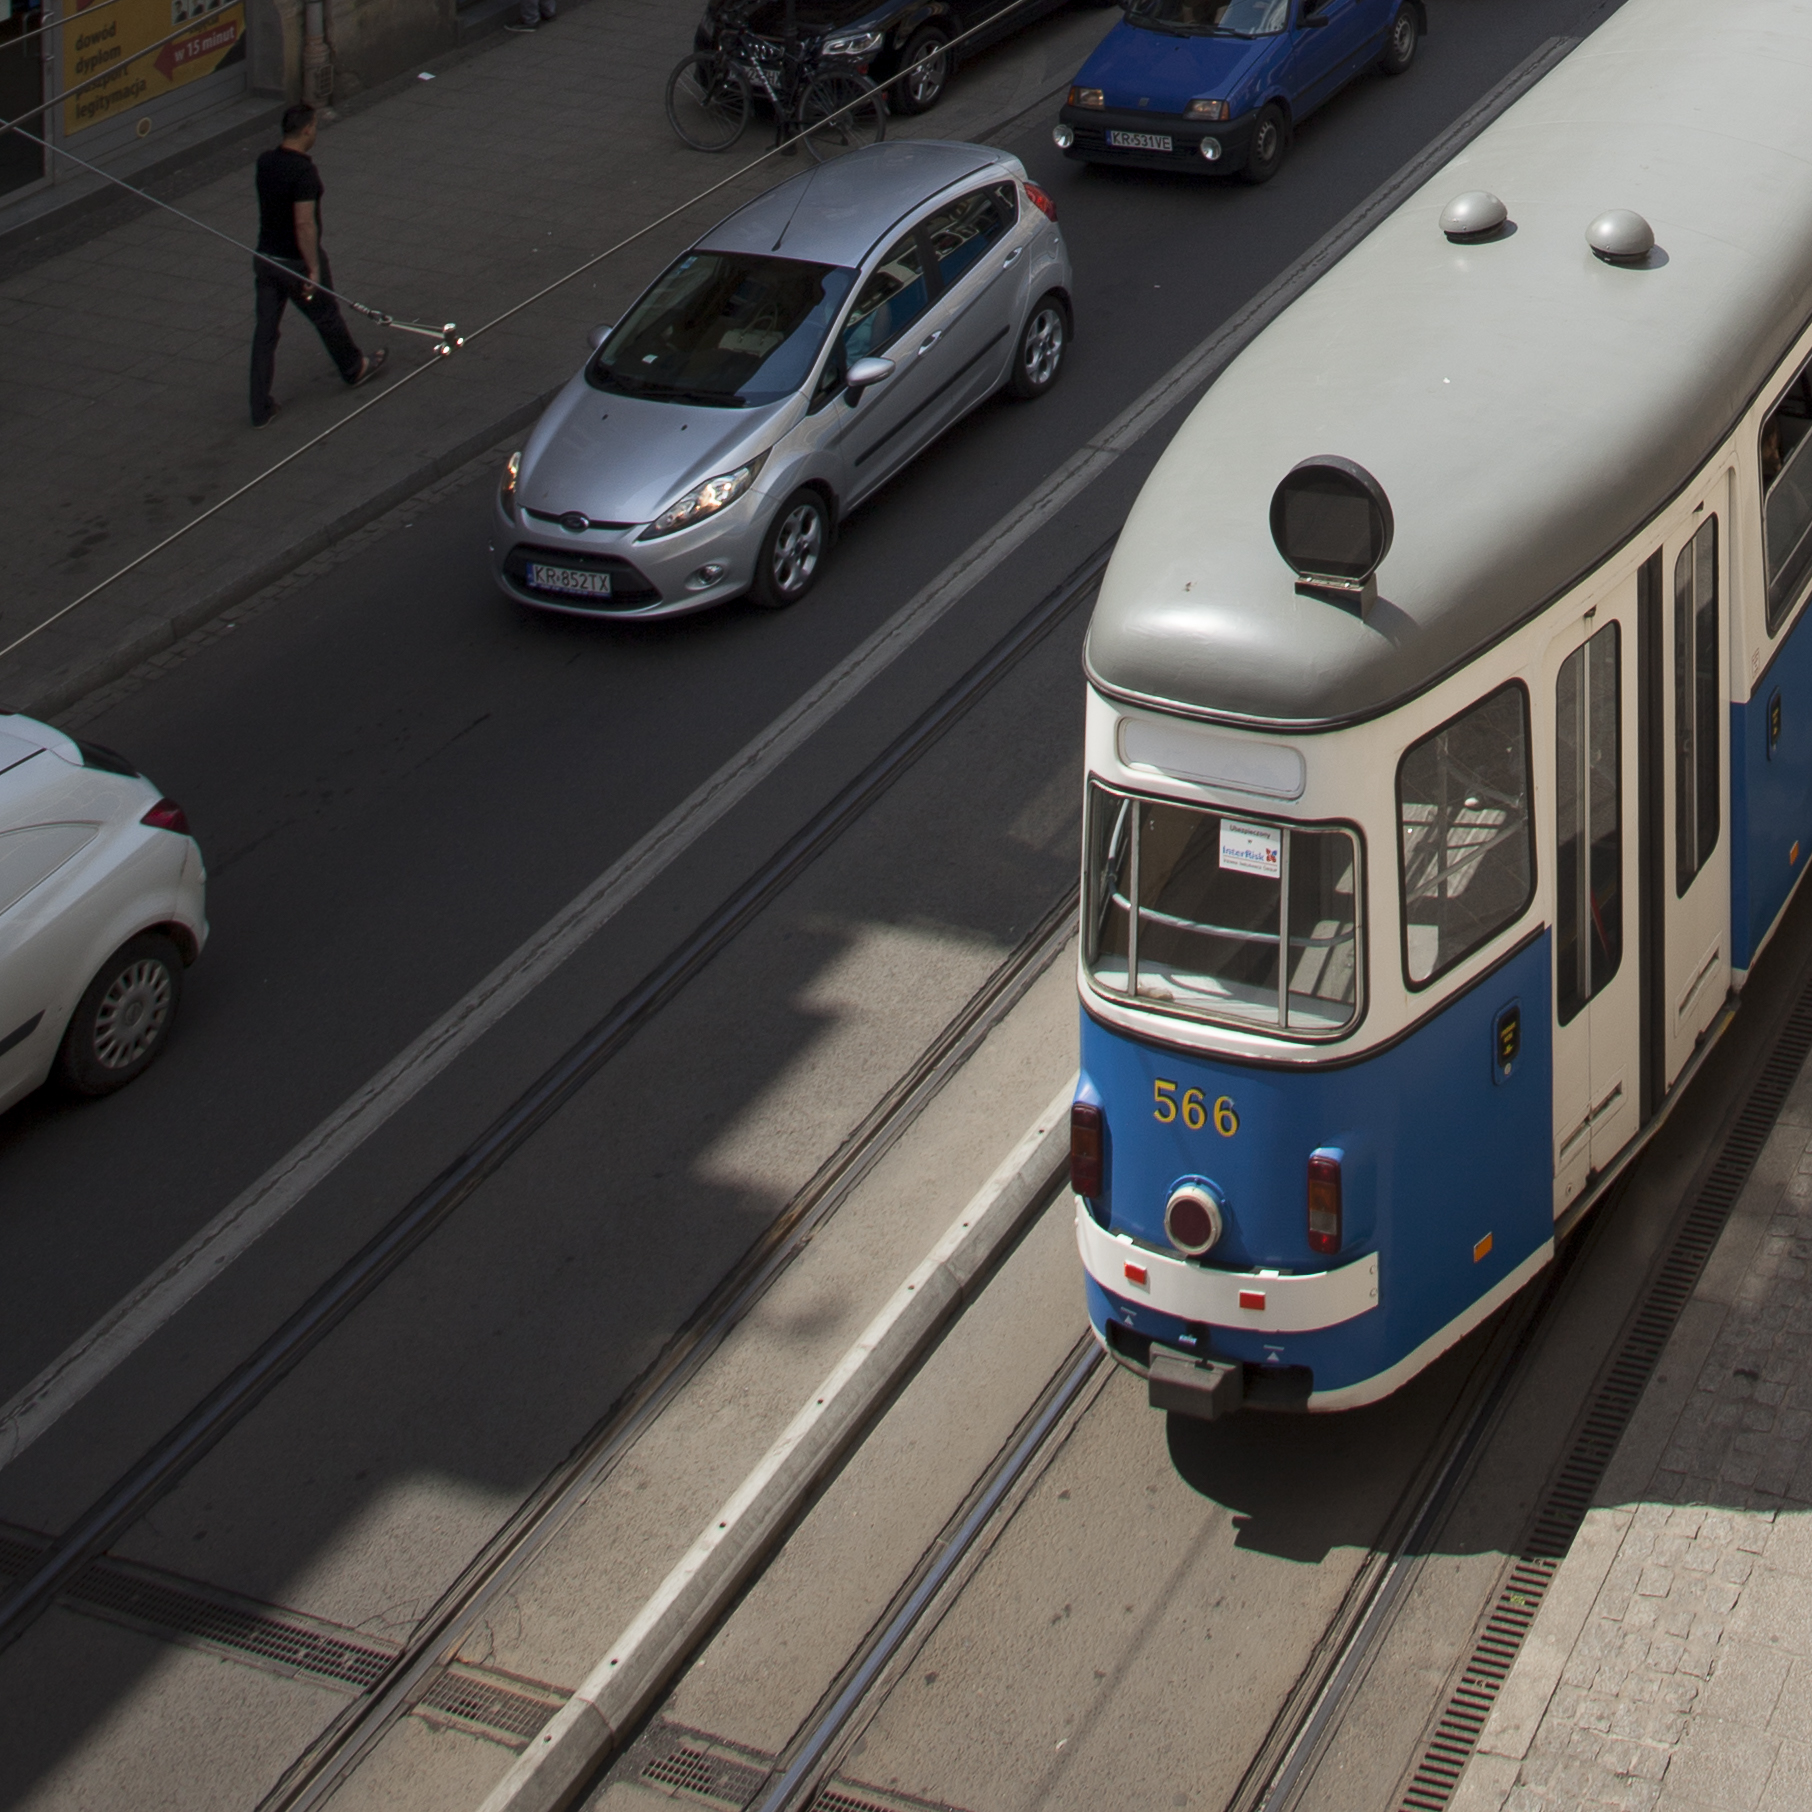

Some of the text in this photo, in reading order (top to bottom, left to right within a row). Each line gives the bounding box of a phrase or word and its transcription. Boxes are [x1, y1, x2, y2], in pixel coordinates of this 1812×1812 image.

[76, 20, 116, 51] dowód
[174, 25, 235, 63] w 15 minut
[75, 45, 121, 76] dyplom
[76, 78, 146, 120] legitymacja
[561, 569, 608, 591] 852TX
[1222, 845, 1265, 861] InterRisk
[1154, 1077, 1240, 1138] 566
